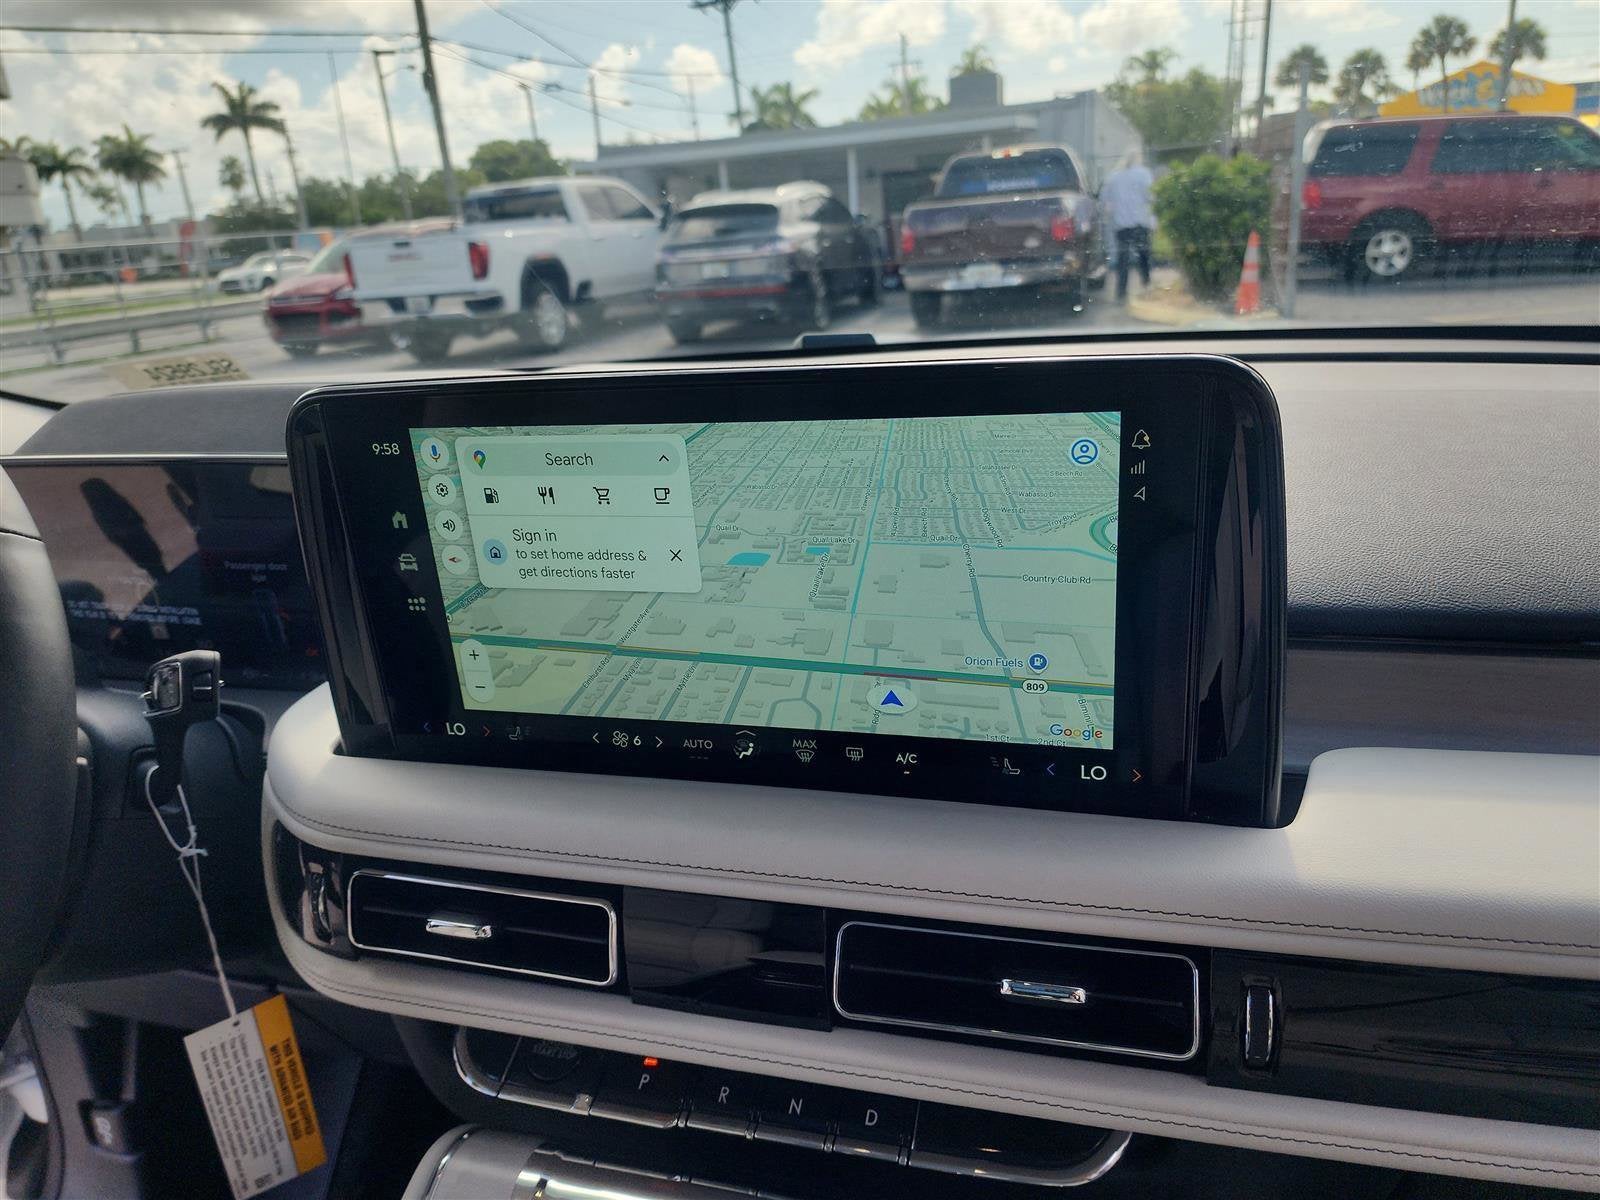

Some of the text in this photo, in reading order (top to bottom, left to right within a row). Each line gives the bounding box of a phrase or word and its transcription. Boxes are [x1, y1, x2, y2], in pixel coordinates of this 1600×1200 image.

[371, 443, 401, 456] 9:58
[544, 452, 594, 466] Search
[715, 524, 733, 532] Quail
[981, 508, 999, 540] Dogwood
[1047, 517, 1063, 528] Troy
[512, 528, 557, 545] Sign in
[812, 536, 856, 545] Quail Lake Dr
[929, 534, 949, 543] Quail
[515, 548, 647, 561] to set home address &
[962, 544, 976, 578] Cherry Rd
[518, 565, 636, 579] get directions faster
[1022, 574, 1092, 585] Country Club Rd
[809, 578, 821, 599] Quail
[619, 608, 651, 644] Westgate Ave
[964, 656, 1024, 668] Orion Fuels
[676, 671, 692, 693] Myrtle
[1026, 682, 1045, 692] 809
[446, 722, 467, 736] LO
[1049, 723, 1103, 741] Google
[632, 735, 642, 746] 6
[682, 738, 713, 750] AUTO
[792, 738, 818, 750] MAX
[985, 734, 1011, 743] 1st Ct
[1036, 738, 1067, 747] 2nd Ct
[895, 752, 918, 765] A/C
[1080, 764, 1108, 781] LO
[637, 1073, 650, 1091] P
[718, 1086, 730, 1105] R
[788, 1098, 806, 1116] N
[864, 1108, 879, 1127] D
